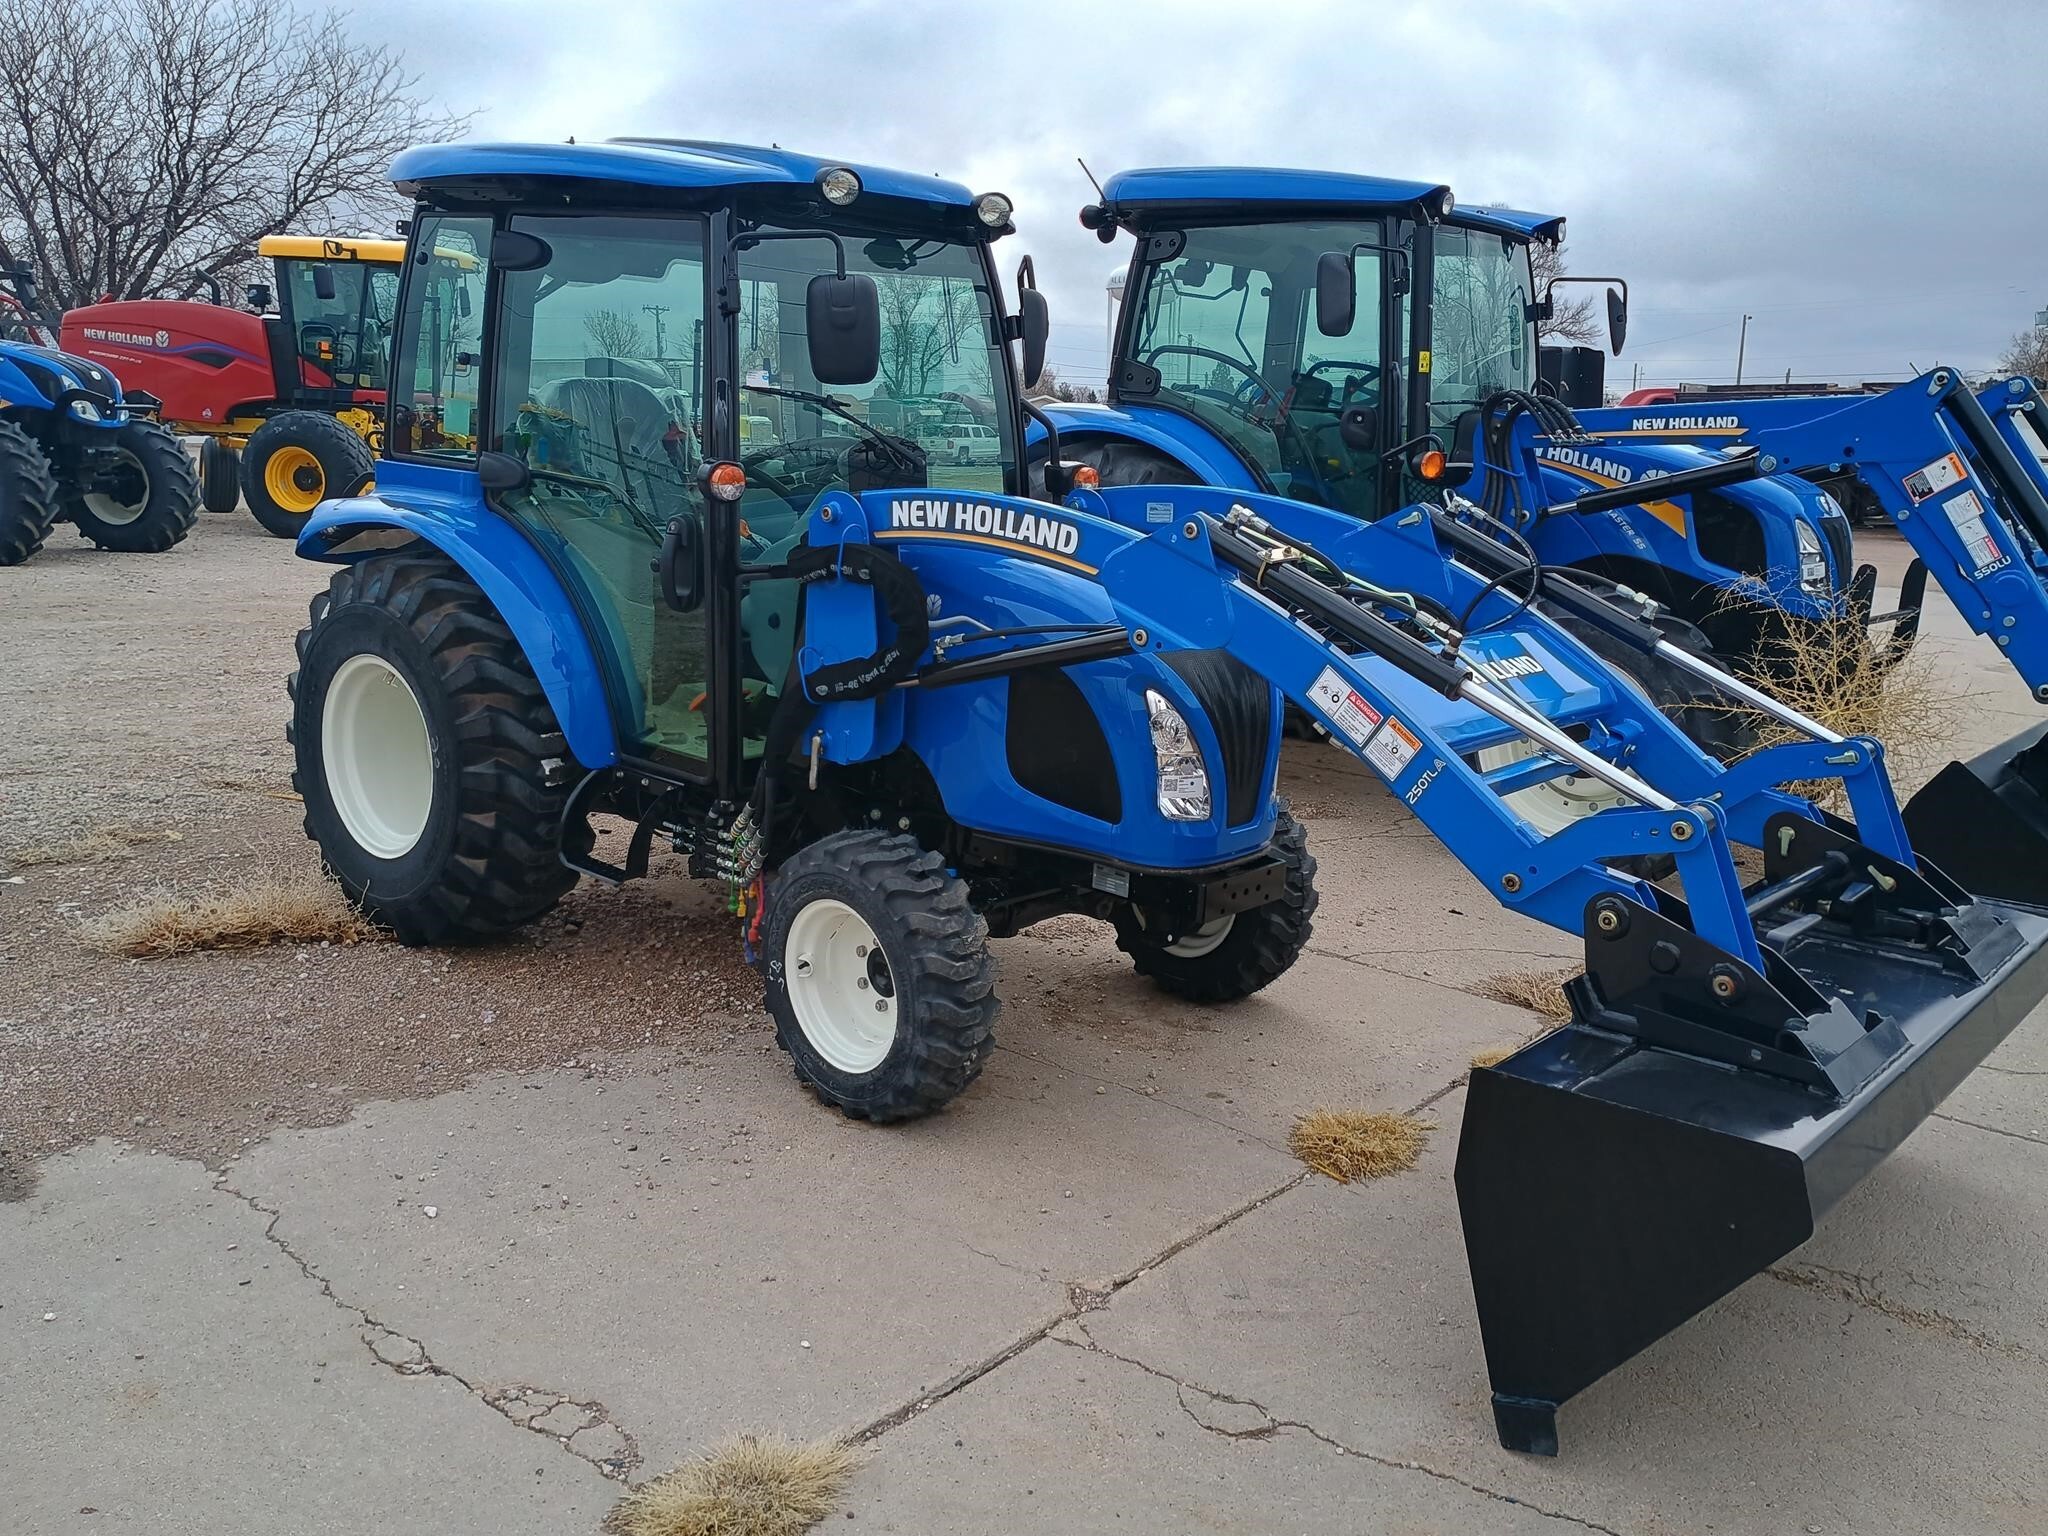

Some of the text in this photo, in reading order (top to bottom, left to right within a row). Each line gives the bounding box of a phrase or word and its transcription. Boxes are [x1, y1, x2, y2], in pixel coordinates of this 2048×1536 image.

[83, 328, 153, 346] NEW HOLLAND
[1632, 416, 1738, 431] NEW HOLLAND
[1547, 447, 1632, 483] HOLLAND
[892, 500, 1079, 555] NEW HOLLAND
[1973, 555, 2012, 580] 550LU
[1465, 655, 1544, 684] HLLAND
[1355, 699, 1379, 723] DANGER
